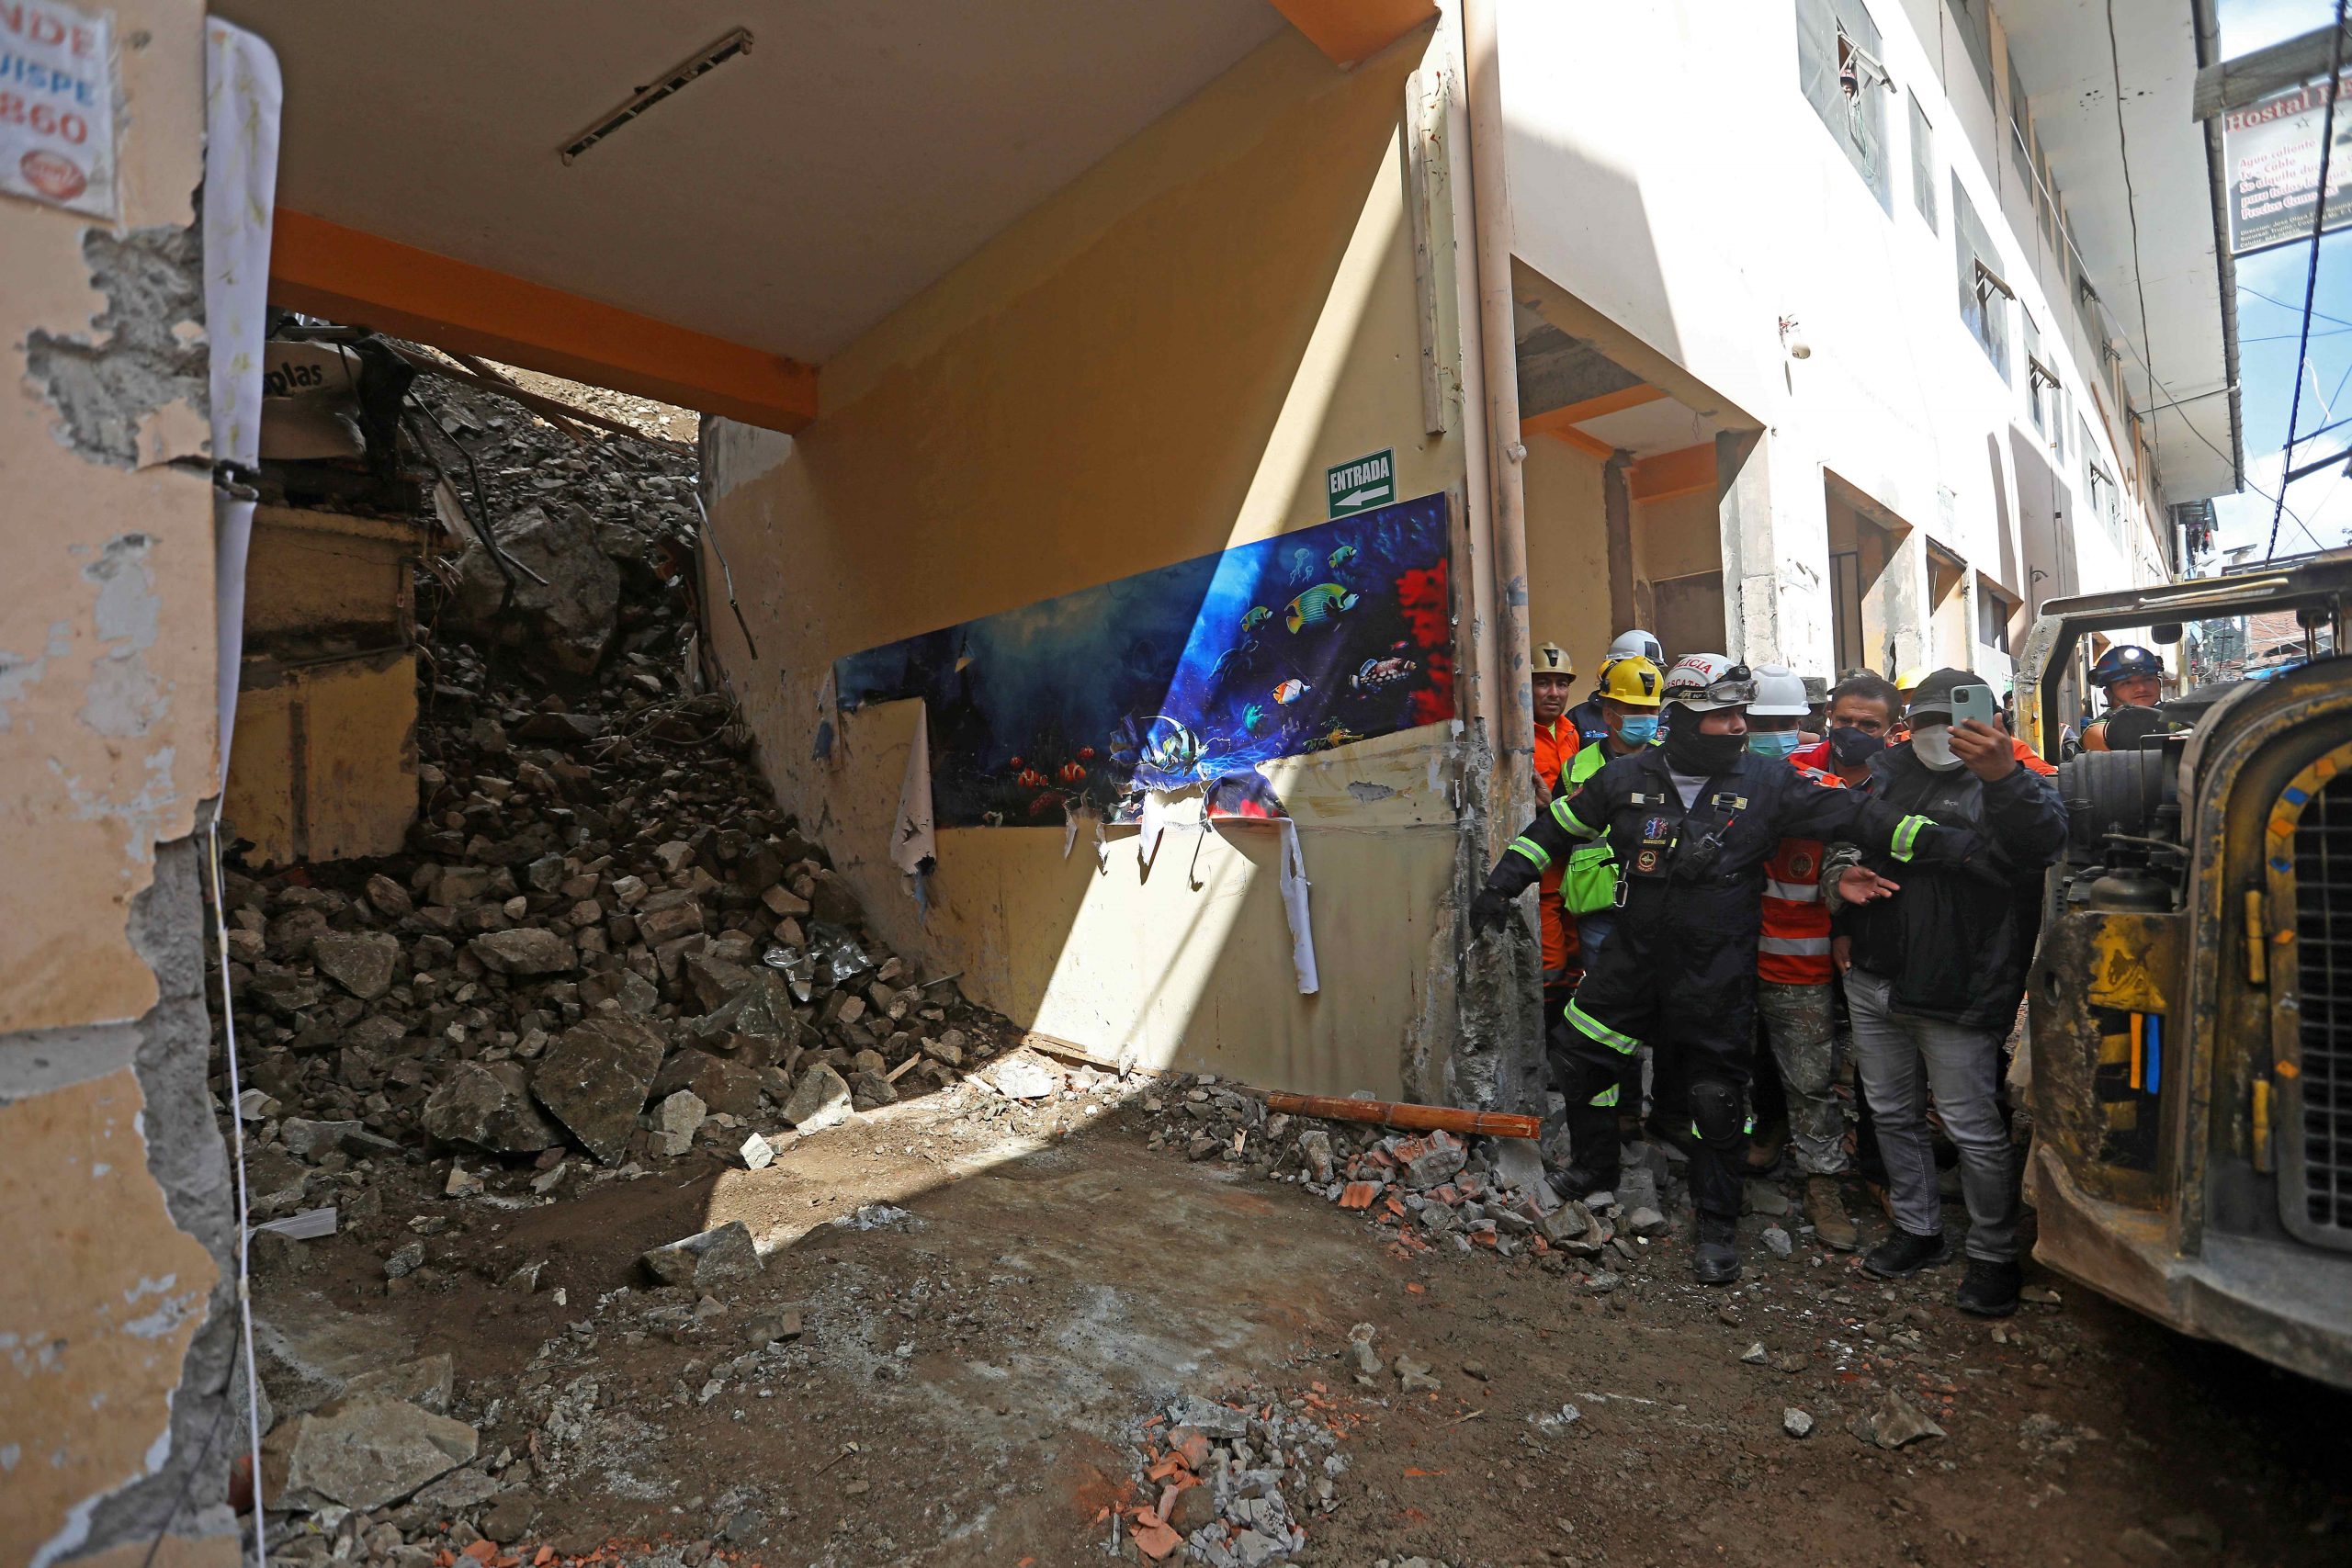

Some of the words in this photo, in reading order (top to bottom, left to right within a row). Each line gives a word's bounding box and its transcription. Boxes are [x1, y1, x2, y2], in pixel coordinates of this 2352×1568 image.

[2226, 86, 2311, 133] Hostal
[2240, 154, 2267, 168] Agua
[2241, 192, 2268, 208] para
[2241, 201, 2282, 220] Precios
[1330, 457, 1389, 494] ENTRADA
